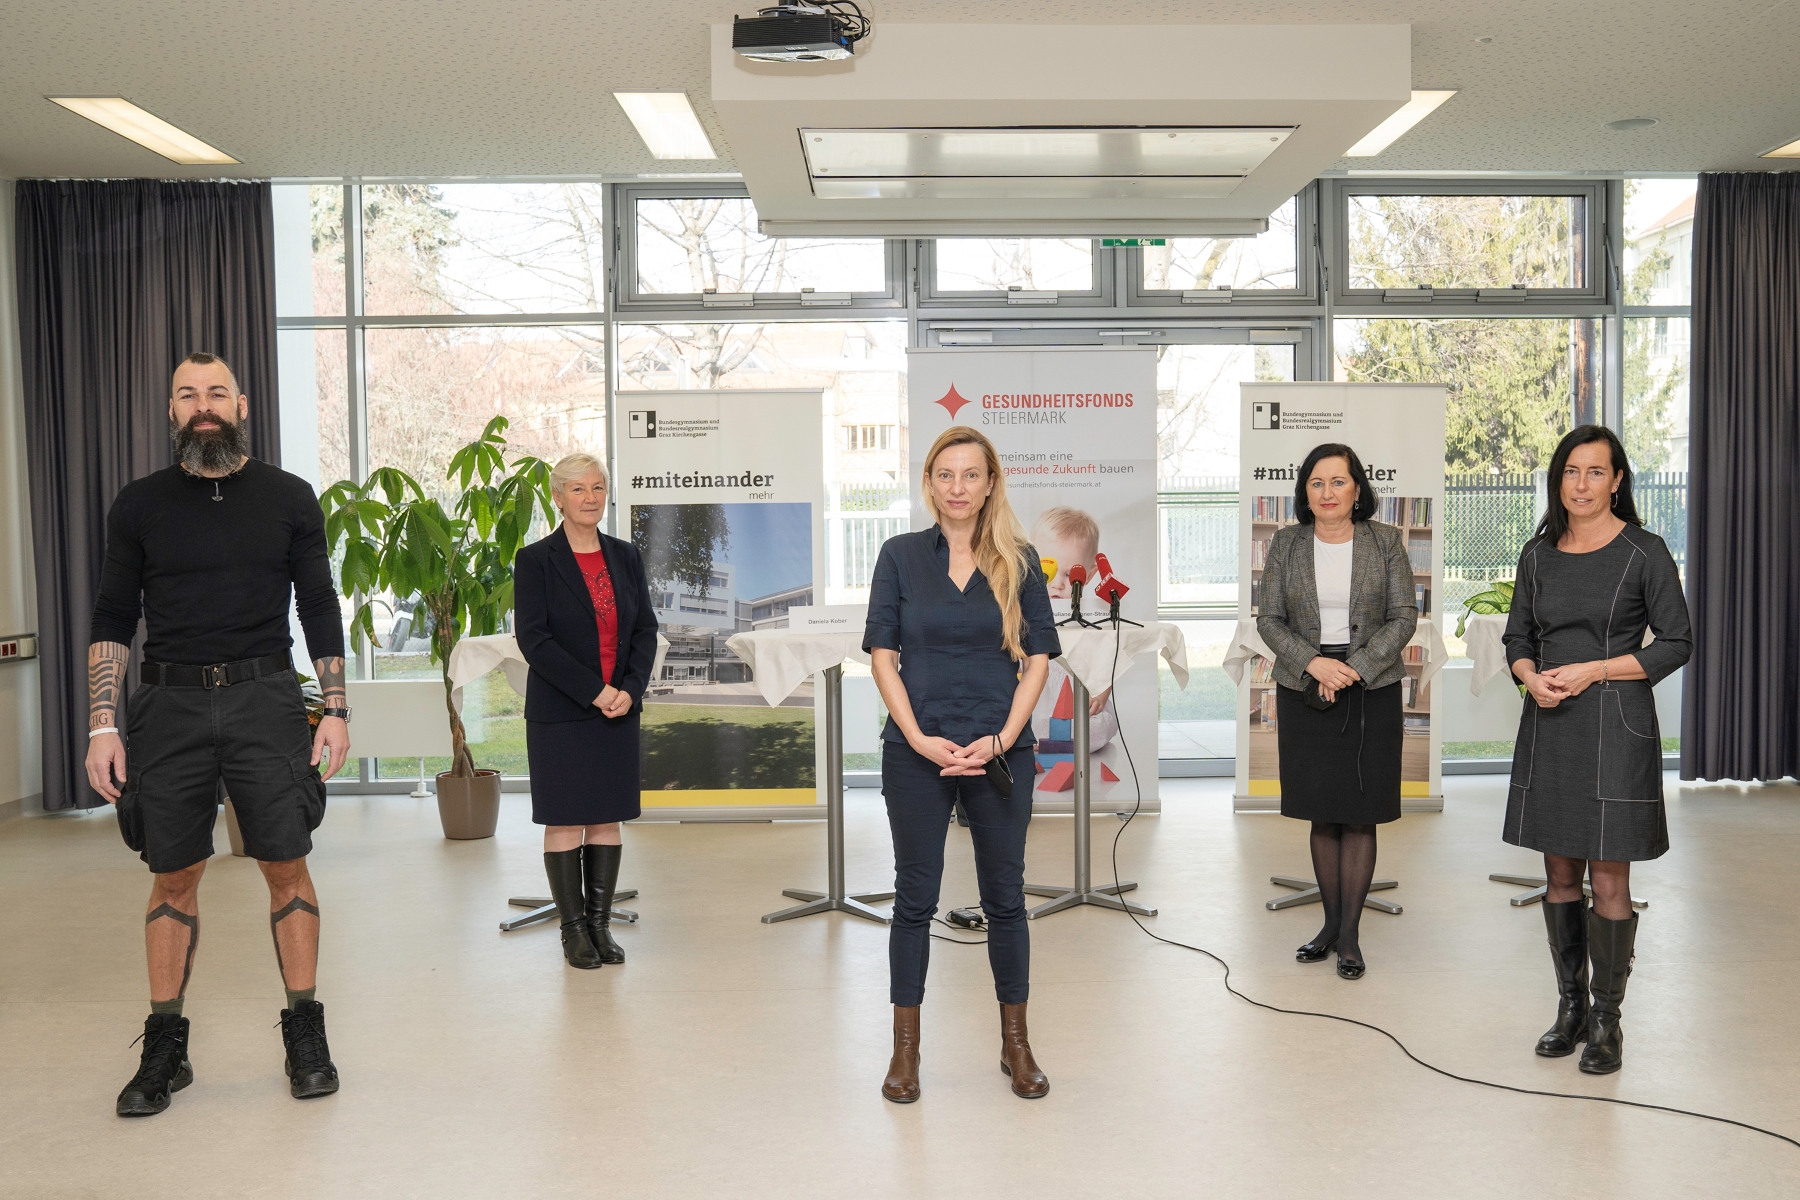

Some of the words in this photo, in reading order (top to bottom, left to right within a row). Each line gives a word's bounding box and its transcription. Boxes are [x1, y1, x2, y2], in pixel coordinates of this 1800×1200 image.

[982, 393, 1133, 409] GESUNDHEITSFONDS
[982, 411, 1067, 425] STEIERMARK
[1000, 452, 1046, 462] meinsam
[1049, 451, 1073, 461] eine
[1004, 464, 1049, 477] gesunde
[1052, 463, 1097, 474] Zukunft
[1099, 463, 1134, 474] bauen
[631, 470, 775, 489] #miteinander
[749, 491, 774, 500] mehr
